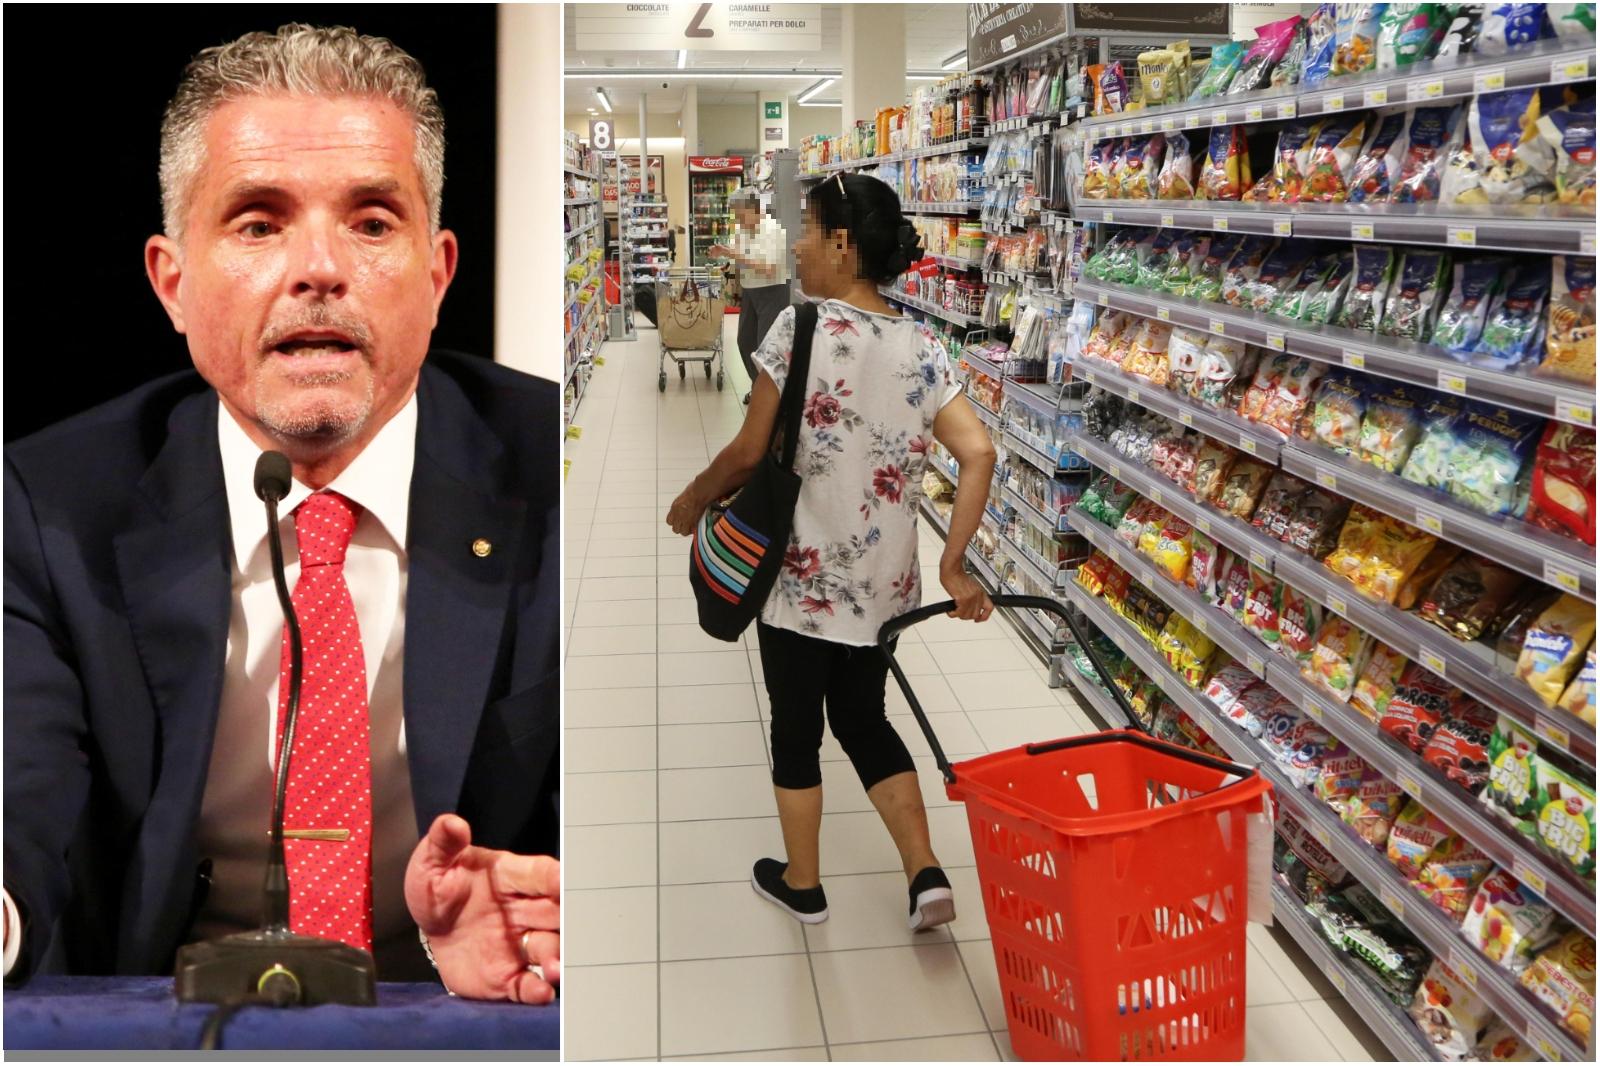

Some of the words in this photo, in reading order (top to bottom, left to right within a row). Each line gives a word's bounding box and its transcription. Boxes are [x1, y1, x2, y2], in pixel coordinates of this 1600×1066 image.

[627, 4, 670, 12] CIOCCOLATE
[728, 4, 771, 12] CARAMELLE
[728, 20, 768, 28] PREPARATI
[769, 20, 783, 28] PER
[785, 20, 806, 28] DOLCI
[594, 121, 610, 149] 8
[1247, 598, 1272, 620] FRUT
[1287, 608, 1304, 627] BIG
[1280, 617, 1306, 642] FRUT
[1503, 754, 1528, 785] BIG
[1490, 764, 1531, 805] FRUT
[1551, 807, 1585, 842] BIG
[1538, 819, 1591, 866] FRUT
